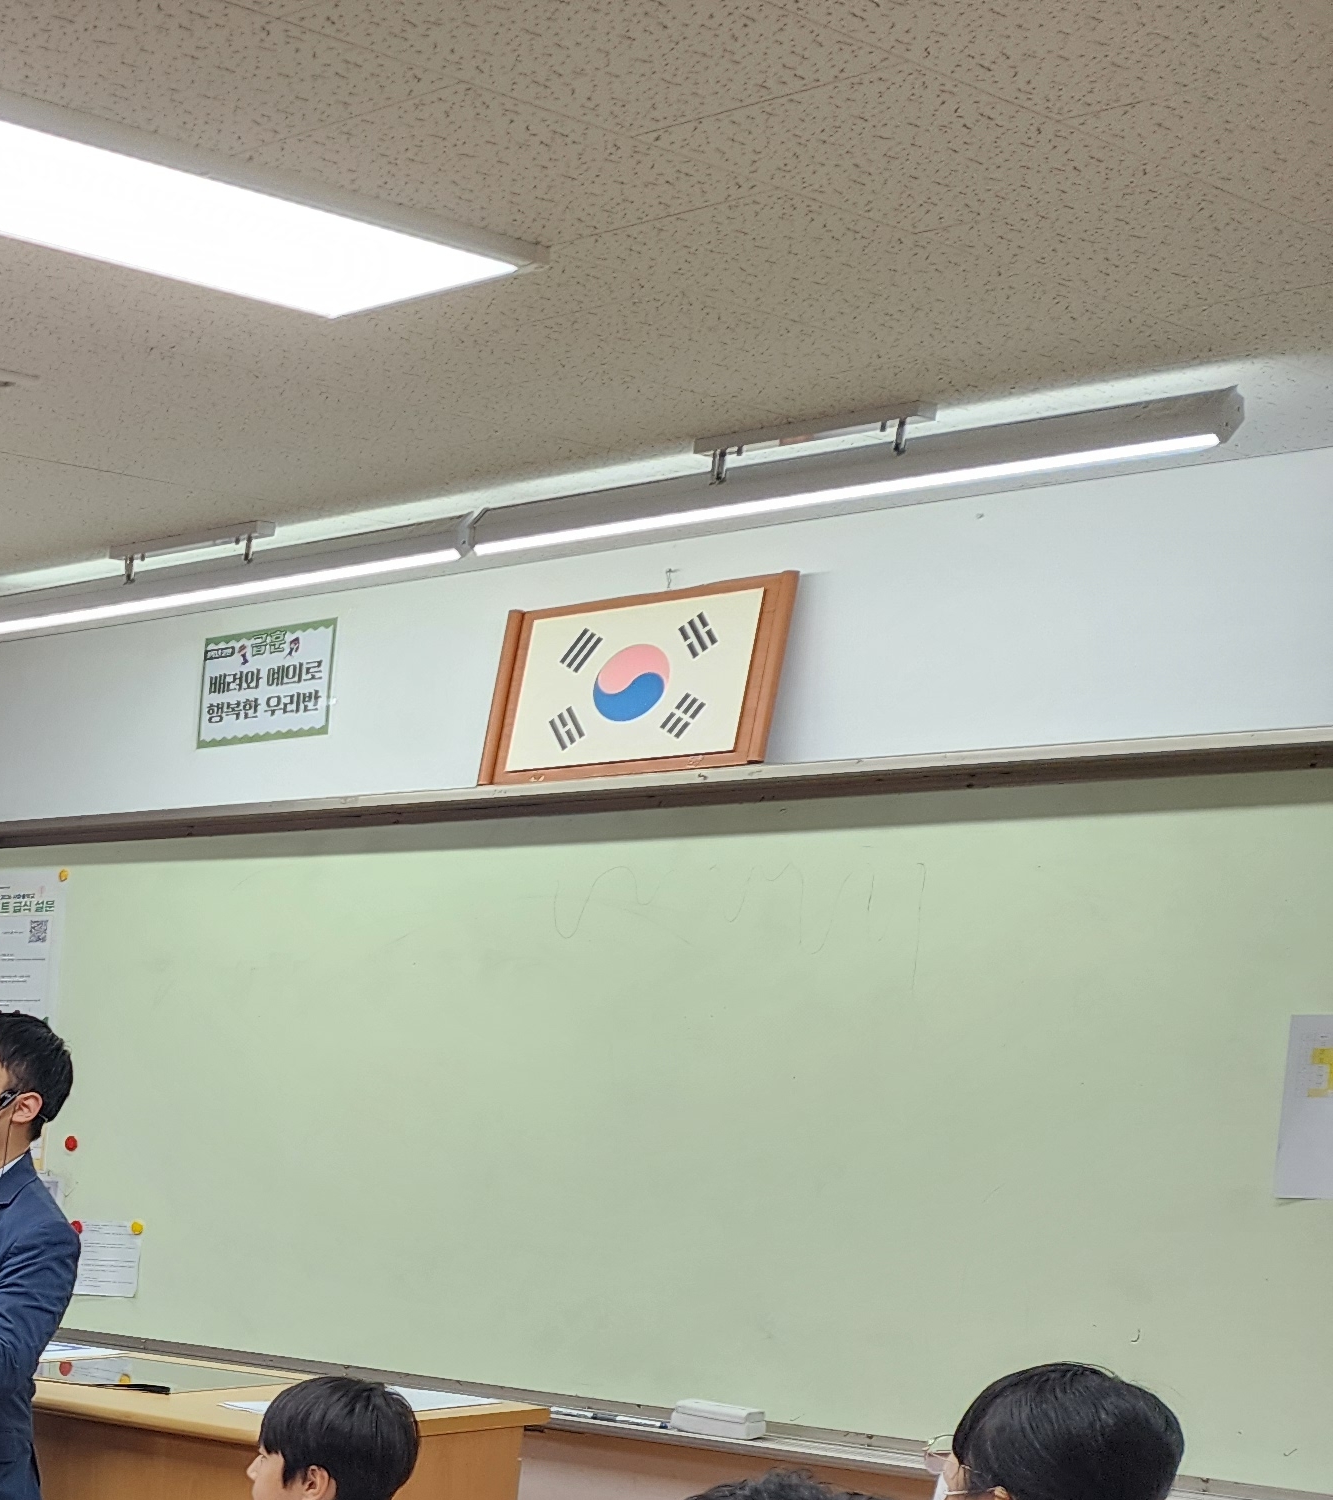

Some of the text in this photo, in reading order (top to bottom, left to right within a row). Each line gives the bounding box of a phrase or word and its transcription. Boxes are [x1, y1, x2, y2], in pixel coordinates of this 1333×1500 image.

[251, 630, 287, 657] 급훈
[208, 659, 324, 695] 배려와 예의로
[206, 688, 322, 724] 행복한 우리반
[13, 901, 32, 913] 급식
[35, 900, 55, 912] 설문
